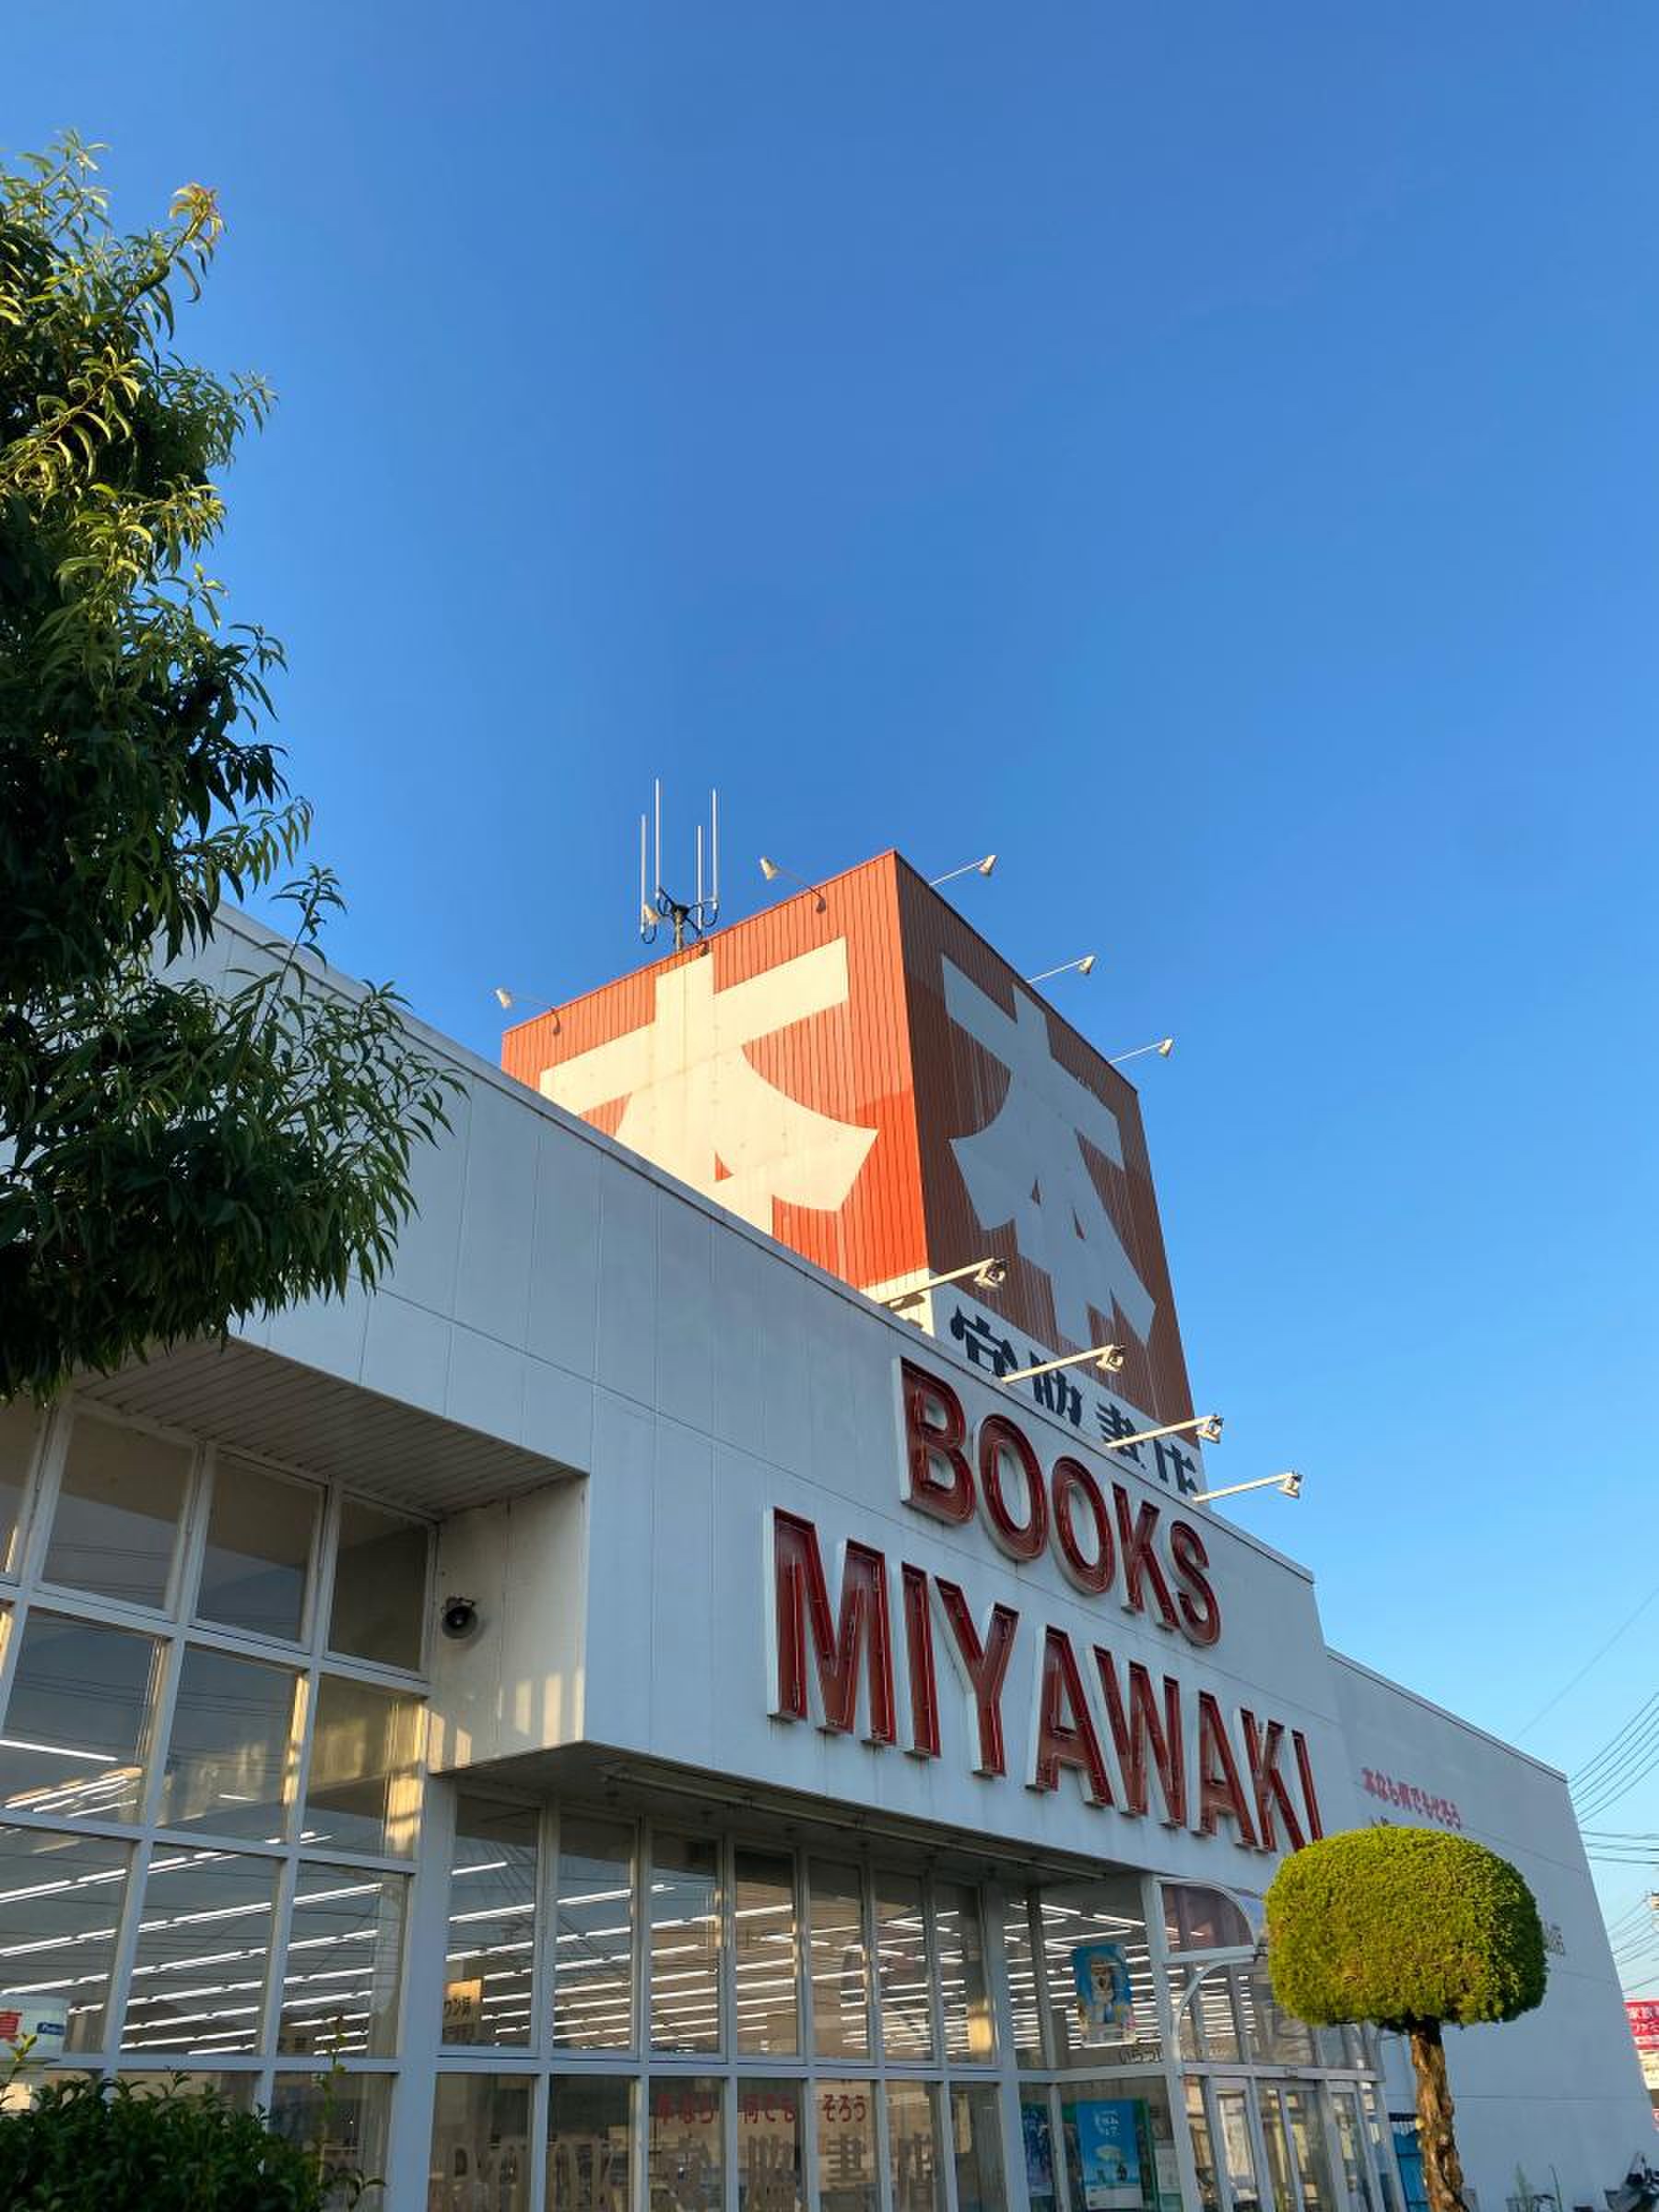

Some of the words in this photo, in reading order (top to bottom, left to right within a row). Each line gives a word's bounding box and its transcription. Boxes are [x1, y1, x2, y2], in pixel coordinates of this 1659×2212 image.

[942, 952, 1156, 1349] 本
[893, 1356, 1221, 1649] BOOKS
[767, 1506, 1327, 1853] MIYAWAKI
